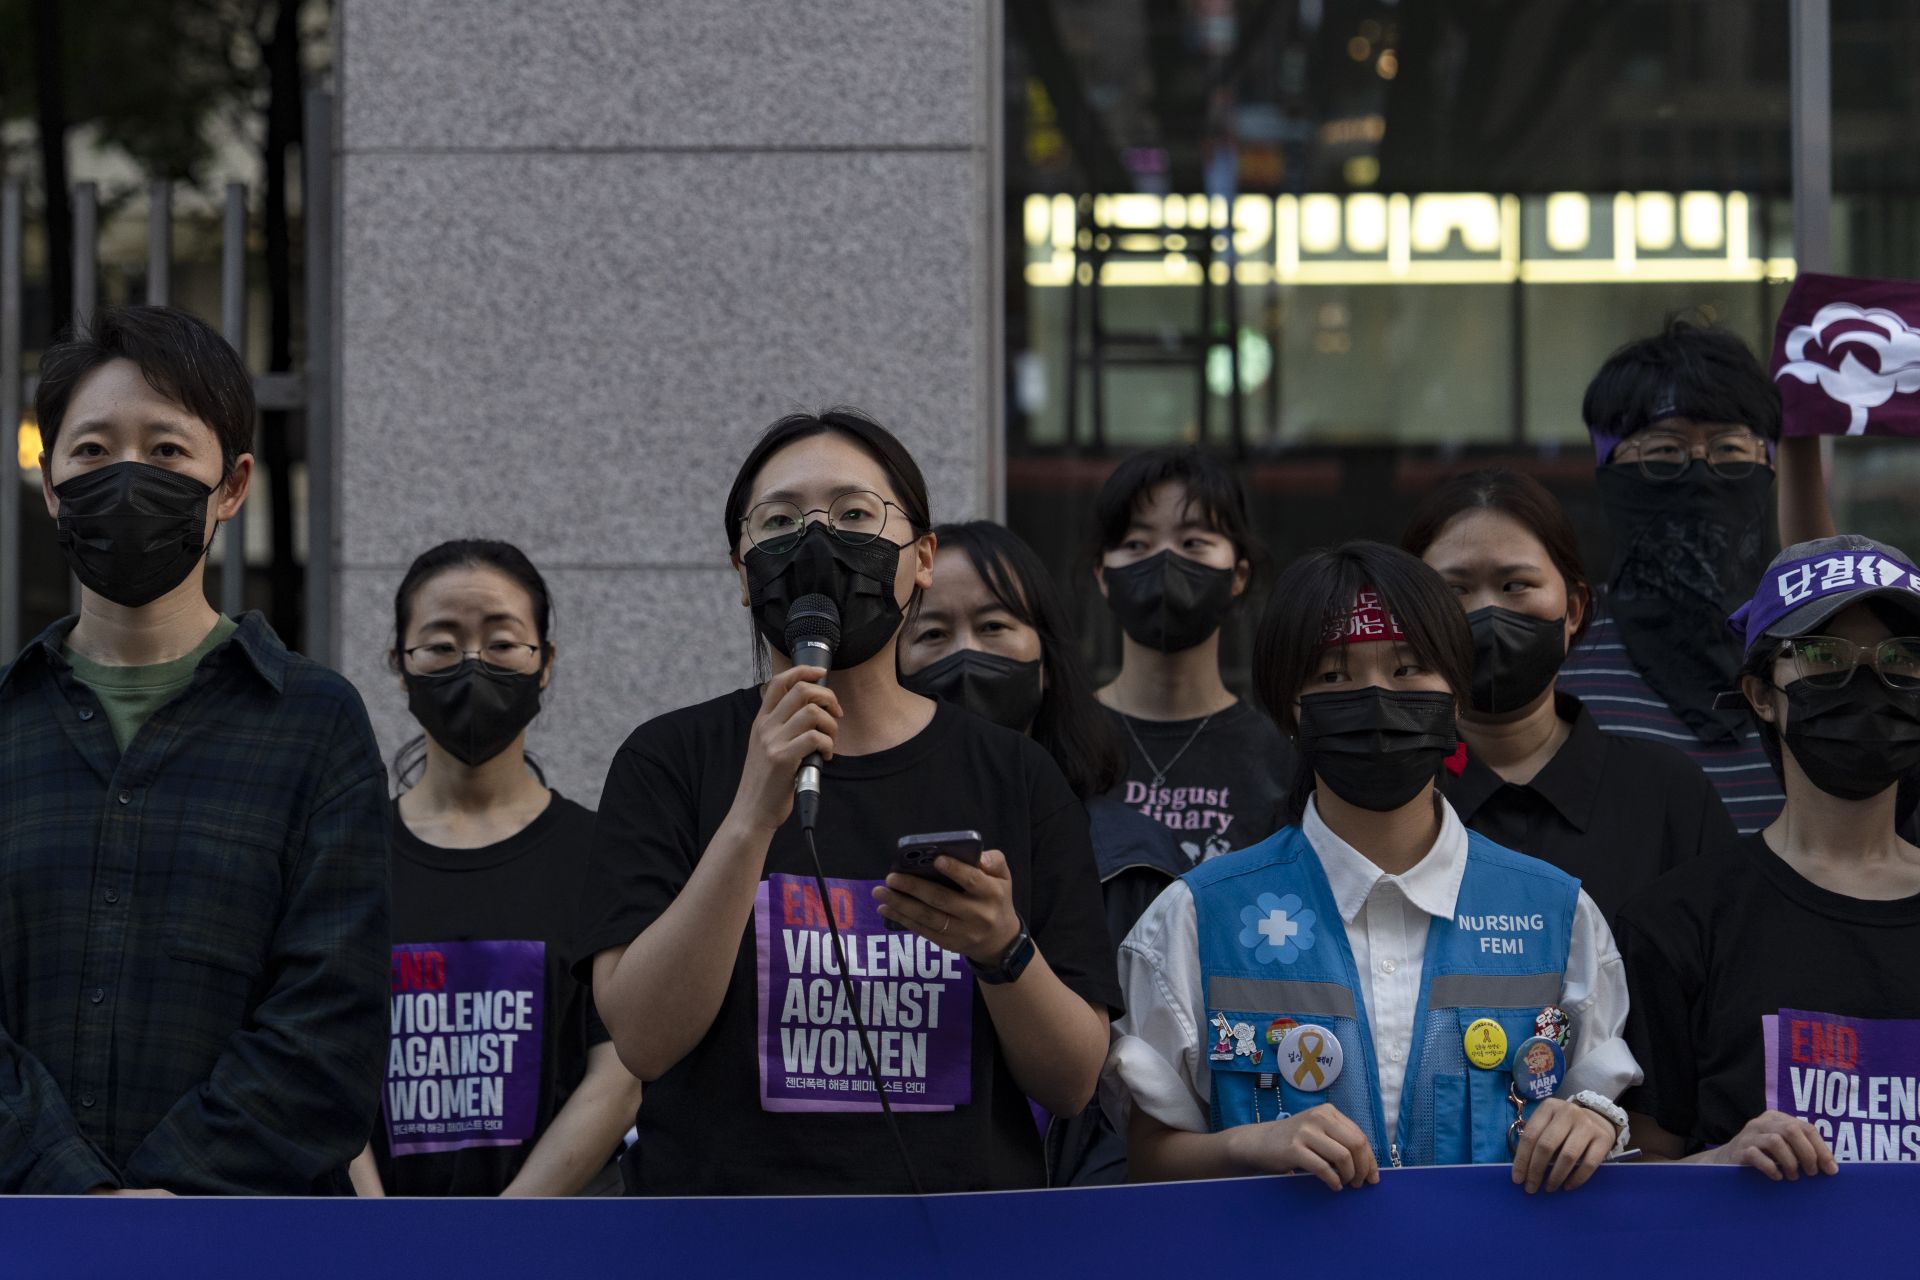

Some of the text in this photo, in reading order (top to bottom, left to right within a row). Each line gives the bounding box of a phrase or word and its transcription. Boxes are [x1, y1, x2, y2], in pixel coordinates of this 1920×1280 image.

[1778, 555, 1855, 606] 단결
[1124, 780, 1229, 810] Disgust
[783, 883, 854, 929] END
[1458, 913, 1544, 932] NURSING
[782, 929, 962, 980] VIOLENCE
[1480, 937, 1524, 954] FEMI
[390, 990, 534, 1034] VIOLENCE
[781, 978, 946, 1029] AGAINST
[388, 1034, 518, 1078] AGAINST
[780, 1028, 927, 1078] WOMEN
[1791, 1019, 1858, 1070] END
[388, 1077, 504, 1121] WOMEN
[785, 1077, 827, 1091] 젠더폭력
[829, 1078, 849, 1091] 해결
[906, 1081, 926, 1094] 연대
[1530, 1074, 1558, 1091] KARA
[1790, 1066, 1920, 1121] VIOLEN
[1796, 1116, 1920, 1163] GAINS
